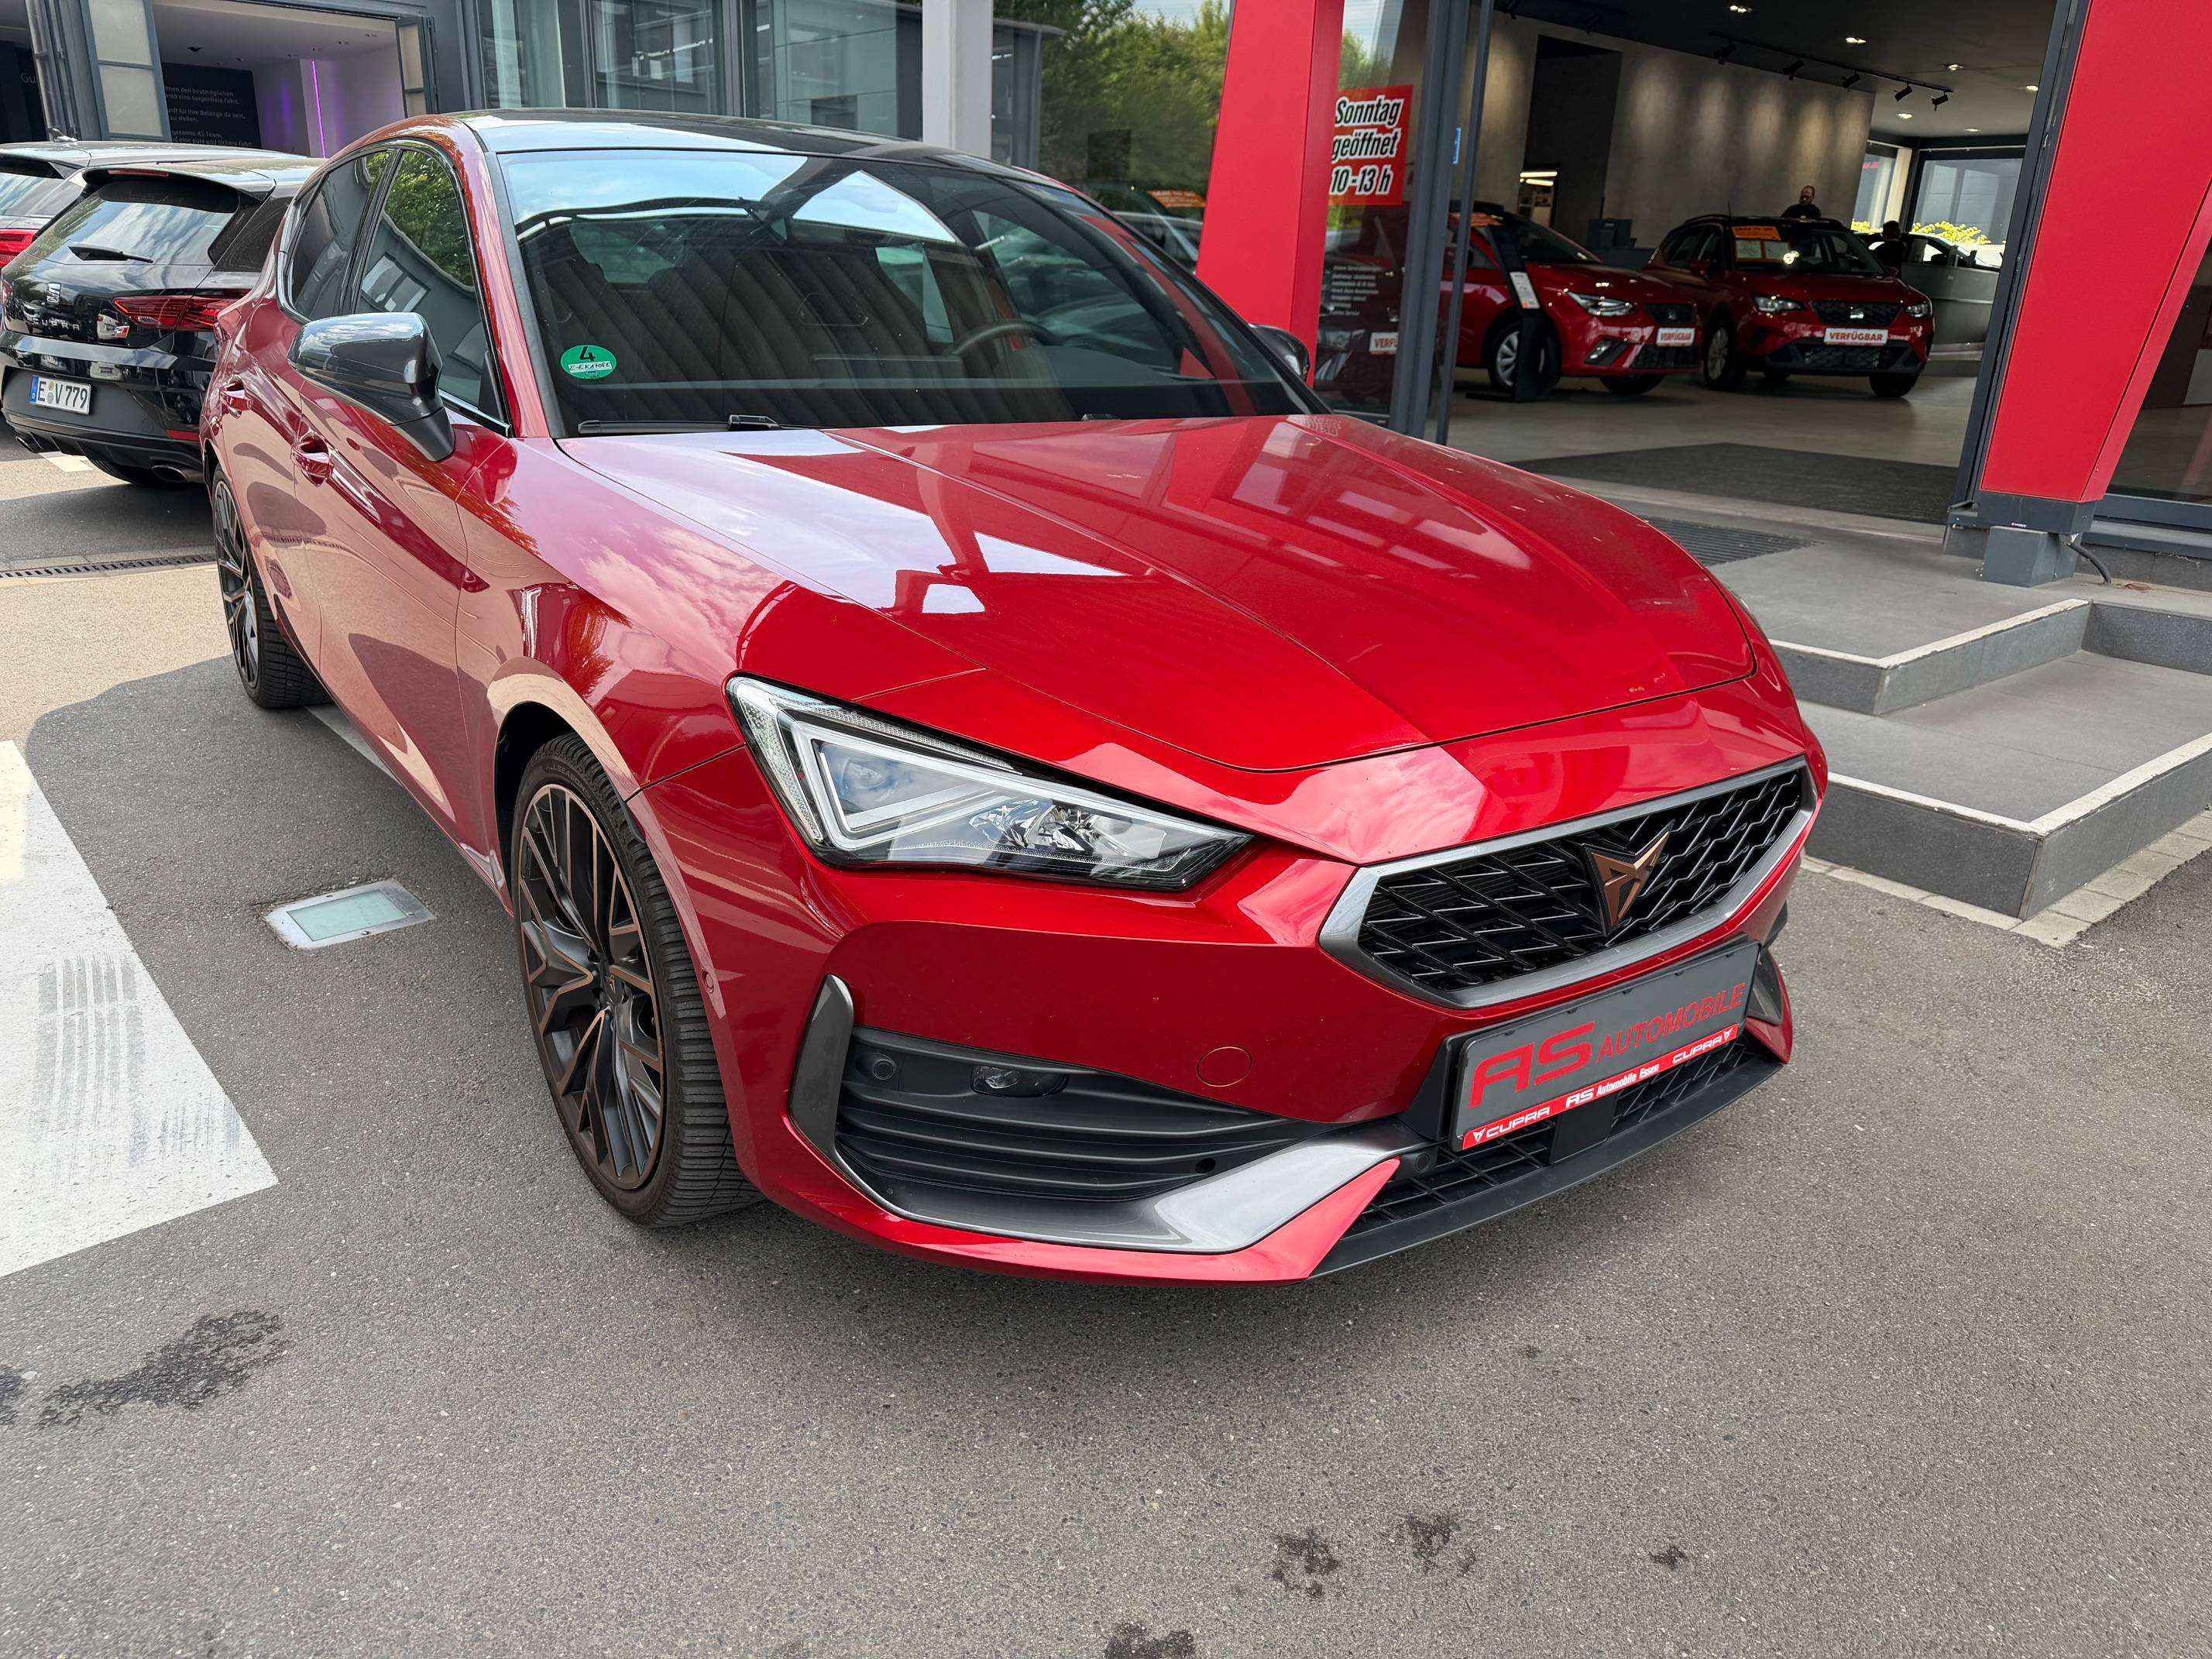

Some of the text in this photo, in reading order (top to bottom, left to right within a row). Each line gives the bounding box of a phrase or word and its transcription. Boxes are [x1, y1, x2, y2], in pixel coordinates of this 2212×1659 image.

[20, 72, 36, 84] Gu
[1334, 97, 1403, 128] Sonntag
[1331, 130, 1400, 162] geöffnet
[1330, 166, 1393, 194] 10-13 h
[1829, 330, 1884, 342] VERFÜGBAR
[579, 345, 596, 362] 4
[38, 380, 46, 402] E
[65, 386, 88, 409] 779
[1468, 982, 1747, 1110] AS AUTOMOBILE
[1486, 1036, 1723, 1138] CUPRA AS Automobile Essen CUPRA
